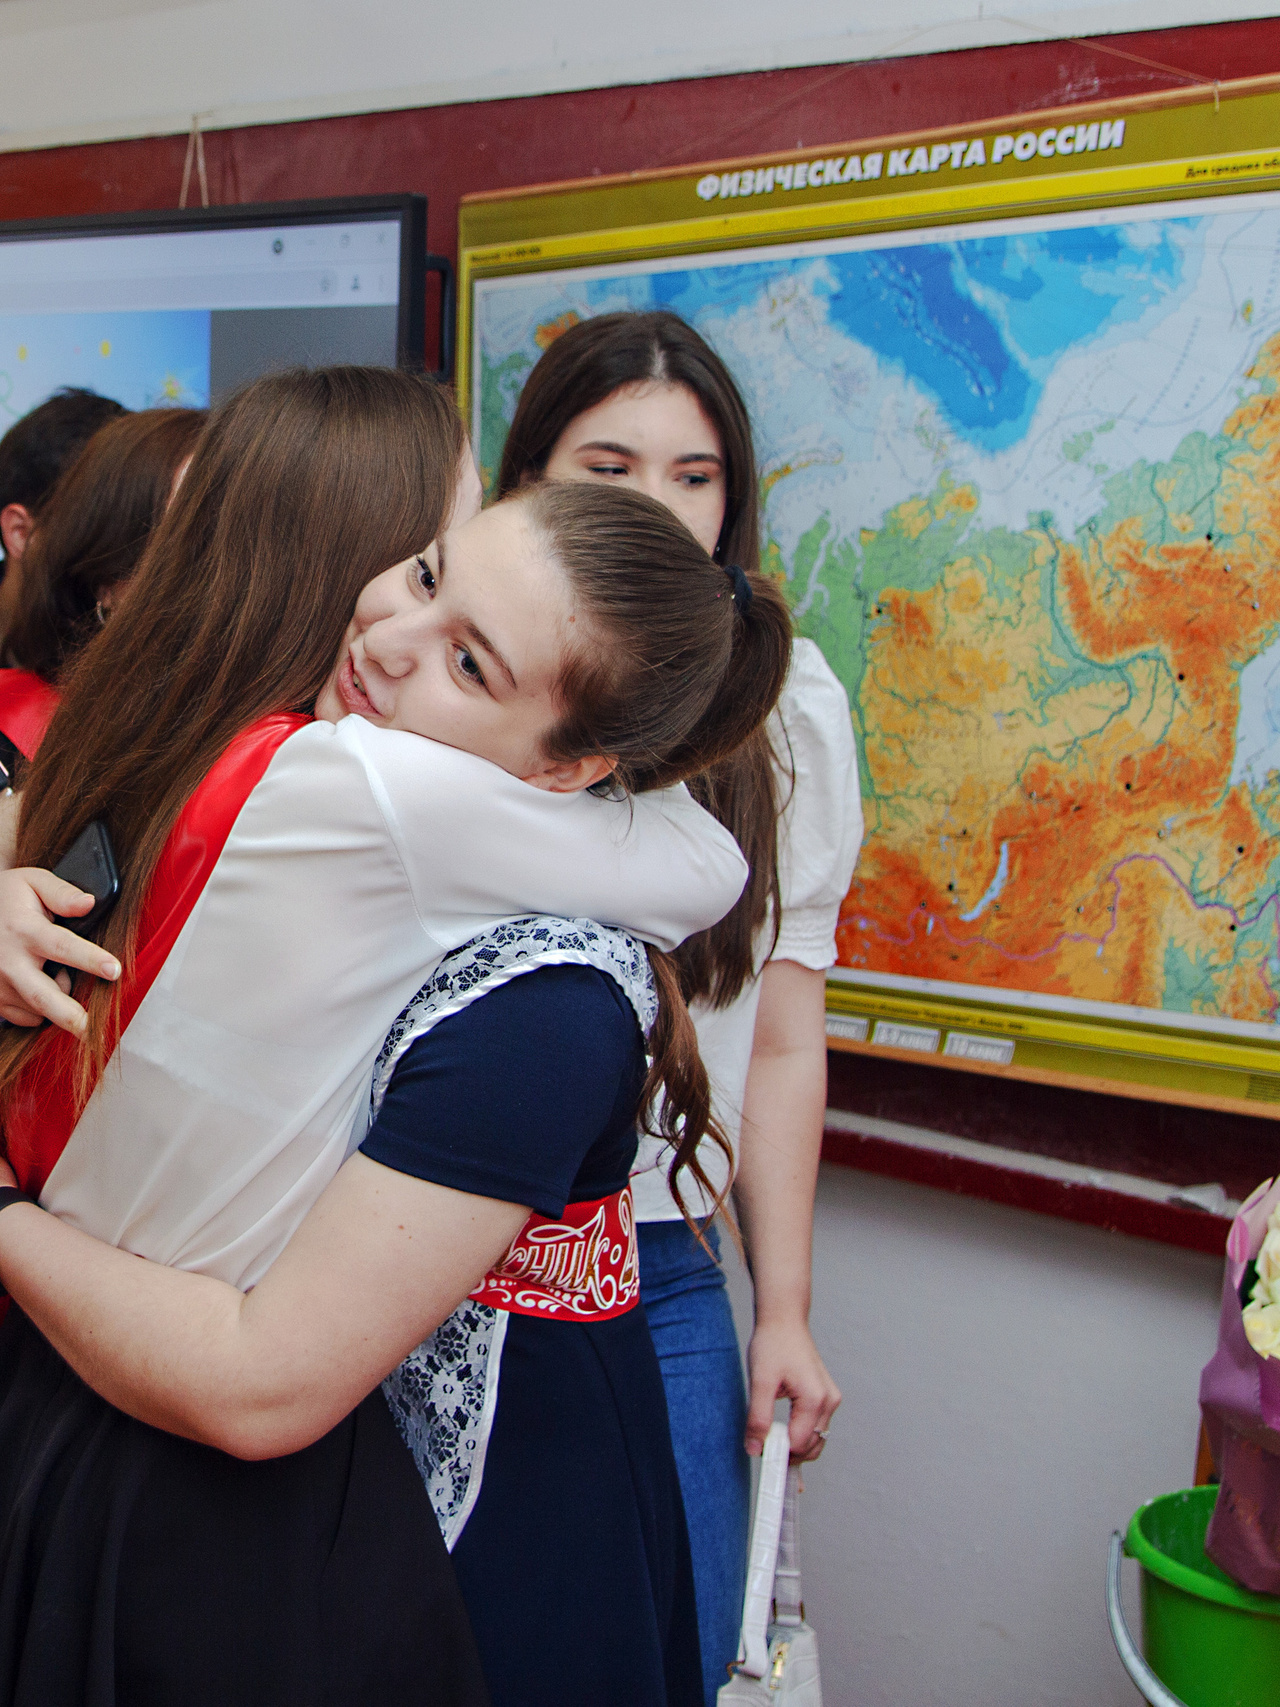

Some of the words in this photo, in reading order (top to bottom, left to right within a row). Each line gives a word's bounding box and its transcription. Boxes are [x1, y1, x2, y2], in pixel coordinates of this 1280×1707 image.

[696, 152, 884, 202] ФИЗИЧЕСКАЯ
[886, 139, 987, 178] КАРТА
[991, 119, 1127, 165] РОССИИ
